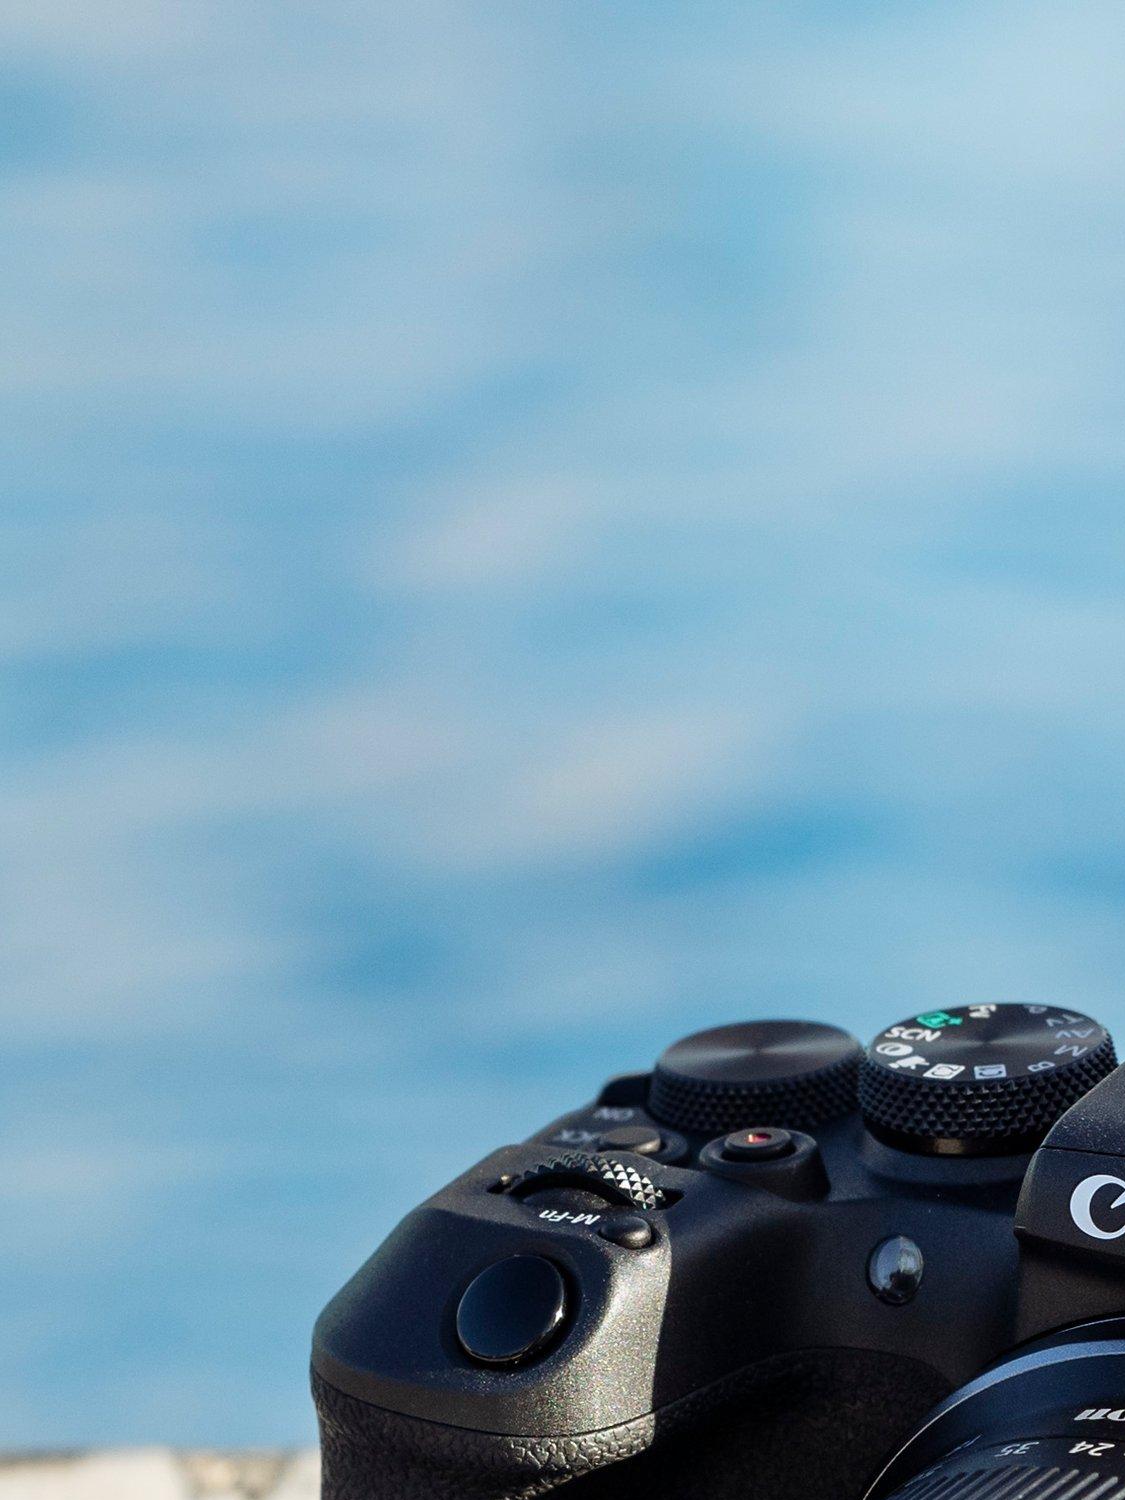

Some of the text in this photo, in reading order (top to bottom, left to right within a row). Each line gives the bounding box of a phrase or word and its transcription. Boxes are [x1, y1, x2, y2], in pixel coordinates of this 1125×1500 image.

[885, 1026, 941, 1042] SCN
[1054, 1044, 1088, 1057] M
[538, 1209, 601, 1226] M-Fn
[994, 1441, 1040, 1458] 35
[1068, 1441, 1116, 1457] 24
